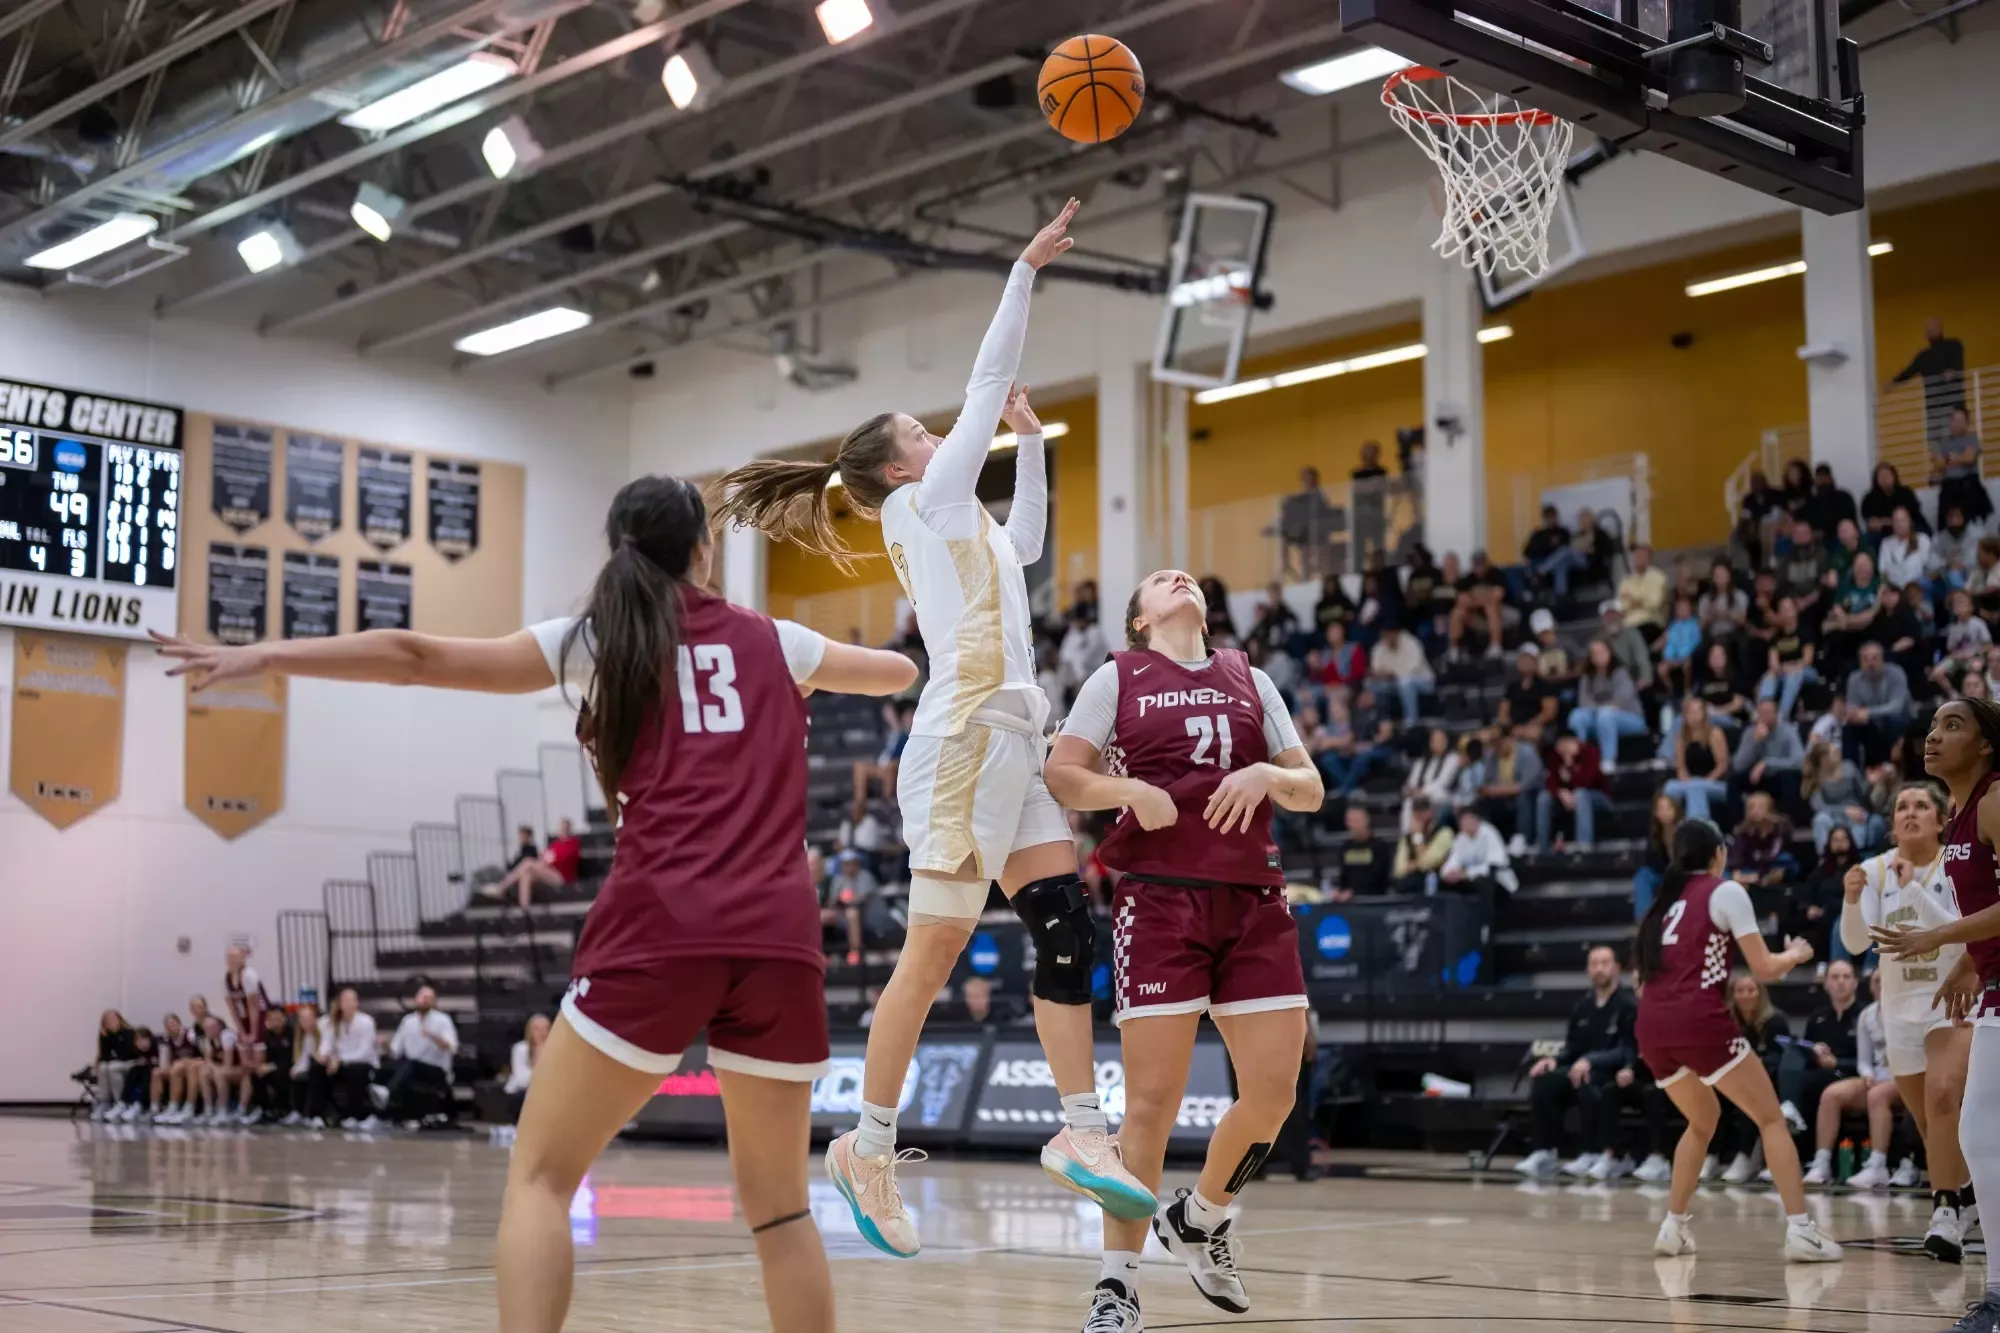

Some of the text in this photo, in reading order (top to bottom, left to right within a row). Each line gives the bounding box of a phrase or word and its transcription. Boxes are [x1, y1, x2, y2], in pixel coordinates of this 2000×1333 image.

[70, 395, 177, 446] CENTER
[0, 428, 33, 465] 56
[50, 491, 88, 526] 49
[30, 545, 86, 578] 4 3
[0, 582, 142, 625] IN LIONS
[676, 644, 745, 734] 13
[1137, 687, 1251, 719] PIONEE
[1184, 714, 1233, 770] 21
[1661, 899, 1687, 946] 2
[1137, 981, 1167, 996] TWU
